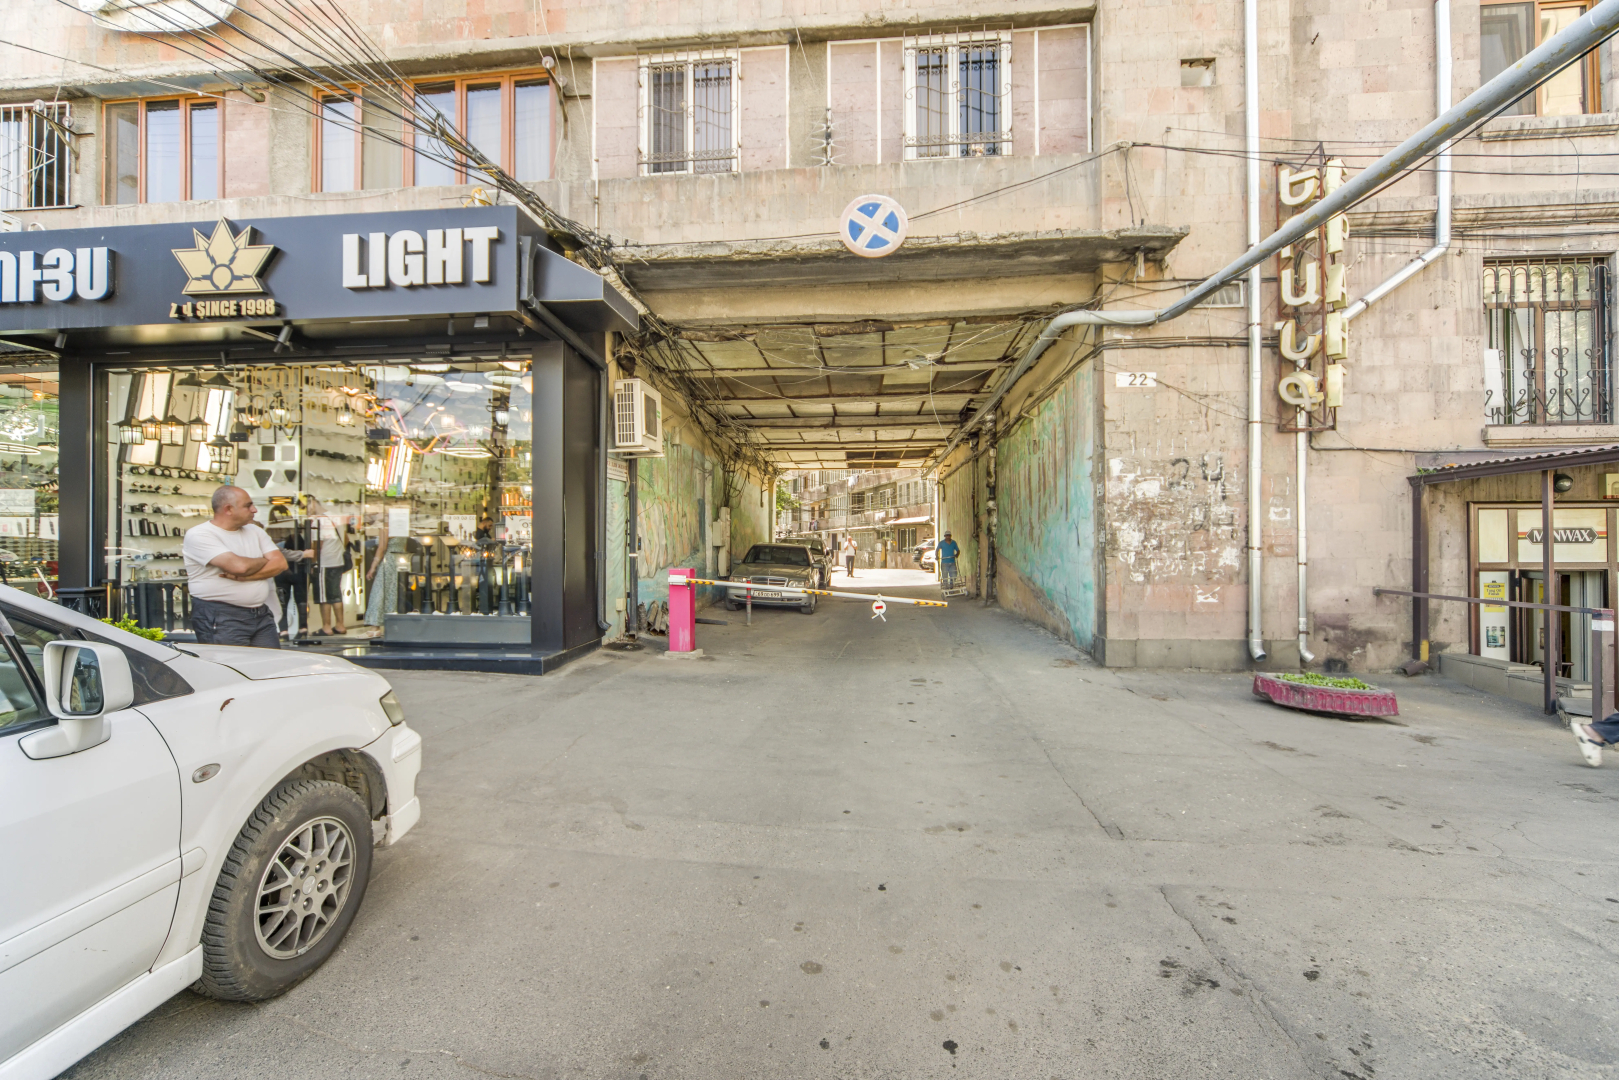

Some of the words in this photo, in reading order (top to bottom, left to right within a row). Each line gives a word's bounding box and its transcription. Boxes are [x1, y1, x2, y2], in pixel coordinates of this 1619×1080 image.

[342, 226, 498, 288] LIGHT
[196, 300, 237, 318] SINCE
[239, 298, 276, 316] 1998
[1128, 372, 1148, 386] 22
[1533, 529, 1591, 542] MNWAX
